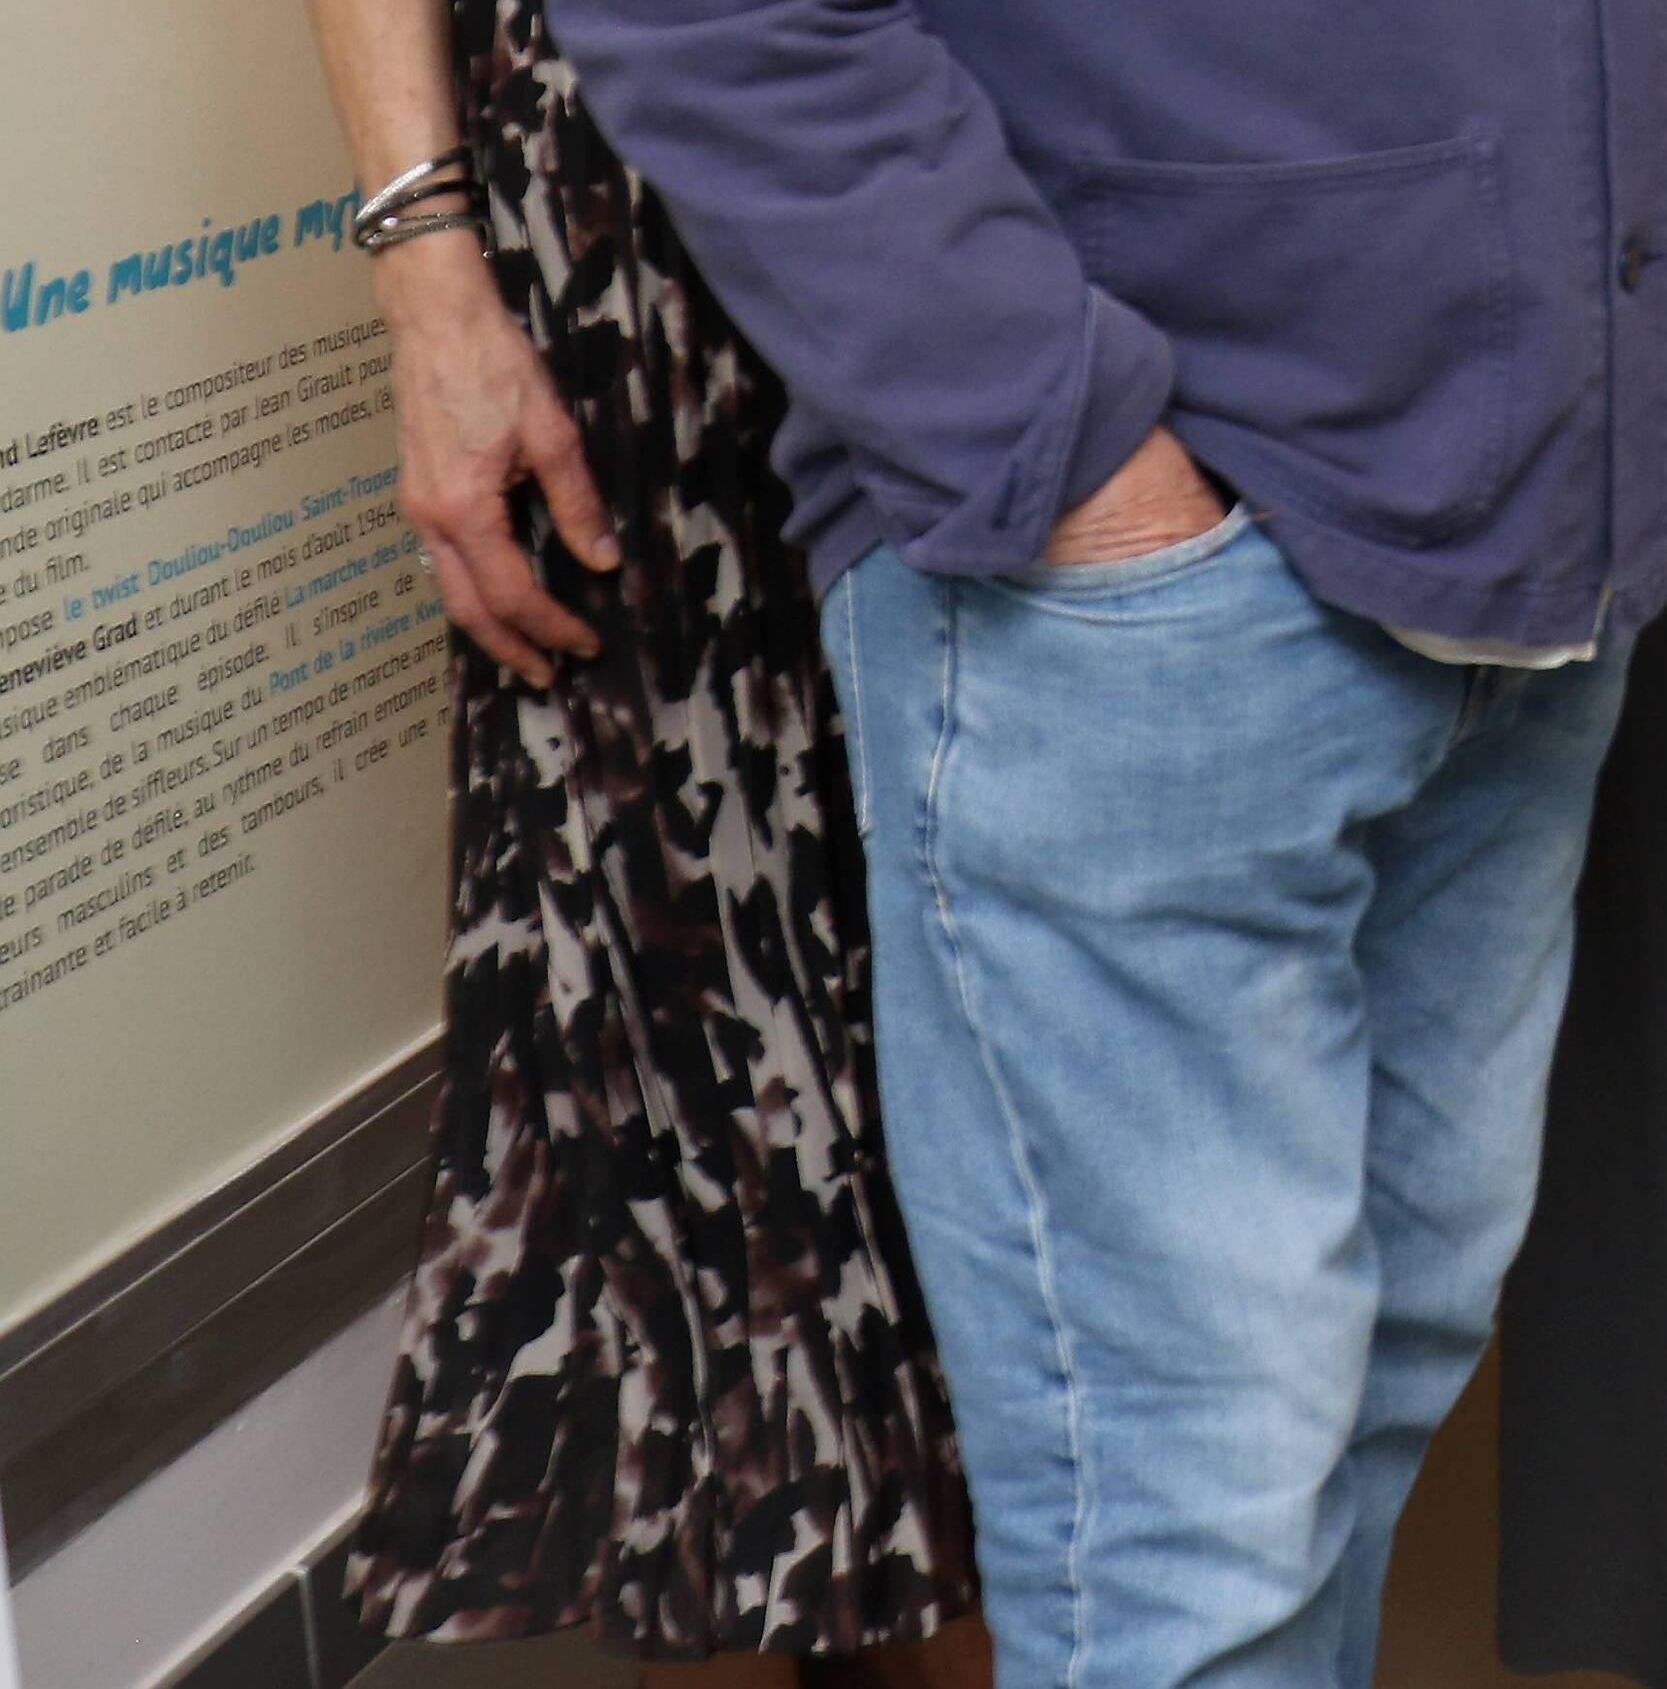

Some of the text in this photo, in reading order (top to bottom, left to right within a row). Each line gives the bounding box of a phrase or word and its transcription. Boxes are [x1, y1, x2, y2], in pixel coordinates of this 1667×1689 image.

[1, 260, 92, 334] Une
[106, 215, 282, 304] musique
[25, 342, 305, 458] Lefèvre est le compositeur des
[77, 457, 90, 486] Il
[98, 450, 127, 478] est
[134, 414, 213, 464] contacté
[220, 406, 250, 438] par
[254, 390, 290, 420] Jean
[297, 365, 353, 403] Girault
[44, 488, 131, 541] originale
[137, 471, 167, 510] qui
[173, 432, 282, 493] accompagne
[286, 421, 310, 447] les
[13, 552, 90, 598] du film.
[63, 594, 83, 622] le
[91, 573, 140, 610] twist
[92, 611, 139, 651] Grad
[143, 606, 163, 631] et
[169, 574, 230, 620] durant
[233, 564, 250, 591] le
[256, 543, 297, 582] mois
[99, 612, 411, 780] de la musique du Pont de la rivière
[109, 683, 178, 734] chaque
[284, 622, 297, 649] Il
[313, 587, 380, 636] s'inspire
[24, 710, 369, 913] parade de au rythme du refrain
[94, 852, 255, 956] et facile retenir.
